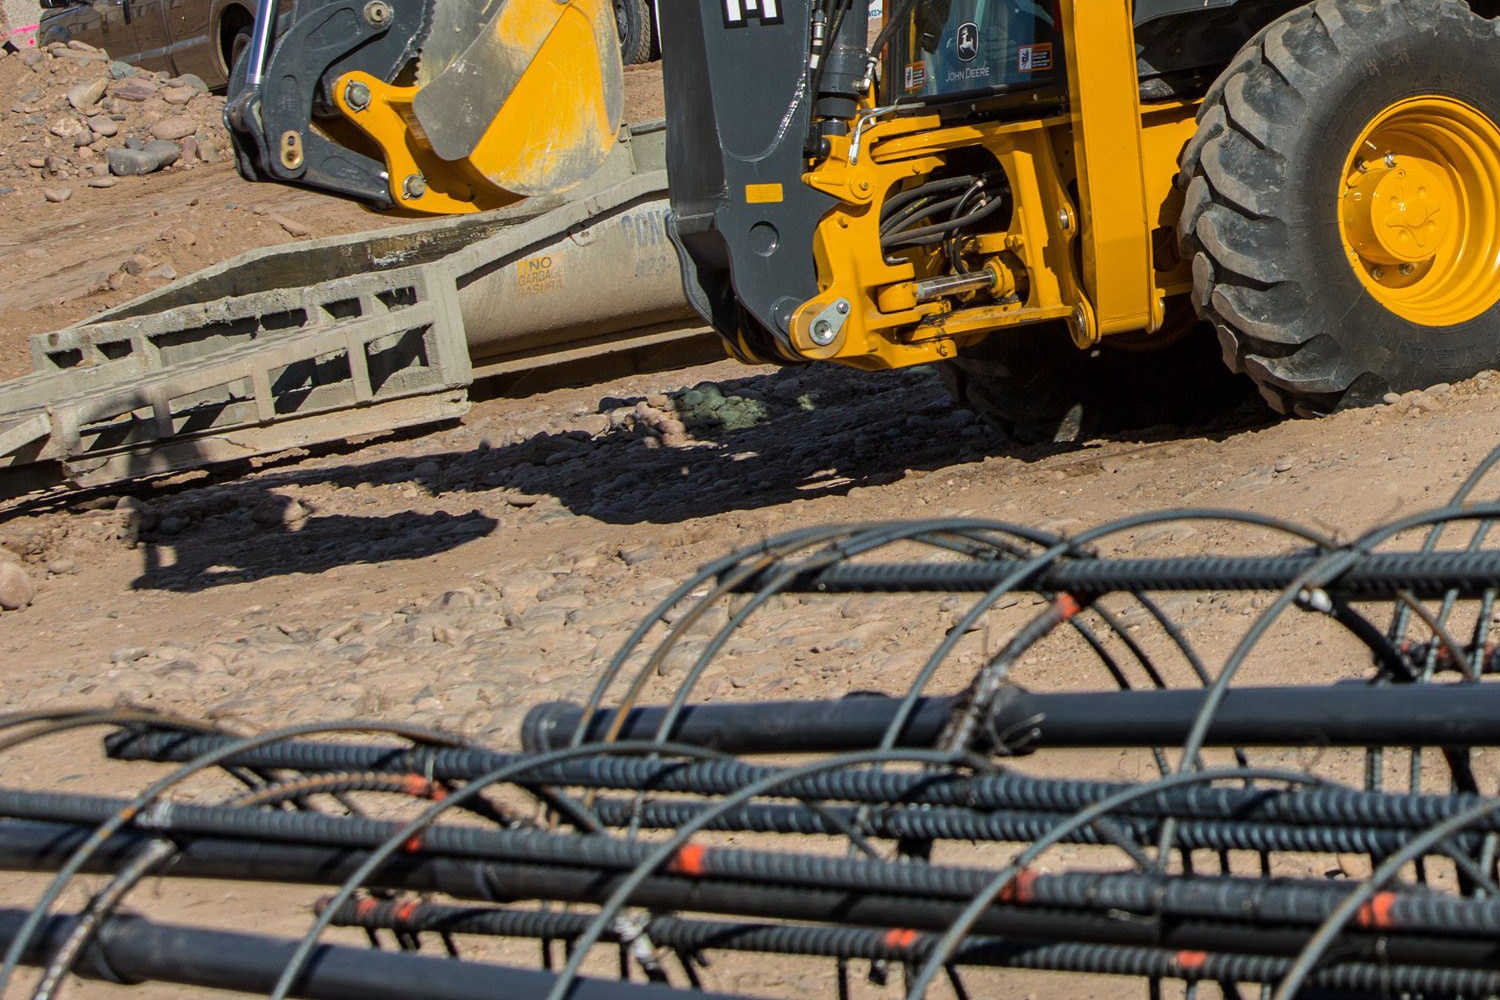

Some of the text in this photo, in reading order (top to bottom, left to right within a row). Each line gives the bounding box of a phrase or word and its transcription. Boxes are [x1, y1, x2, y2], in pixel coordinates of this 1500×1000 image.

[945, 65, 991, 83] JOHN DEERE
[529, 256, 552, 270] NO
